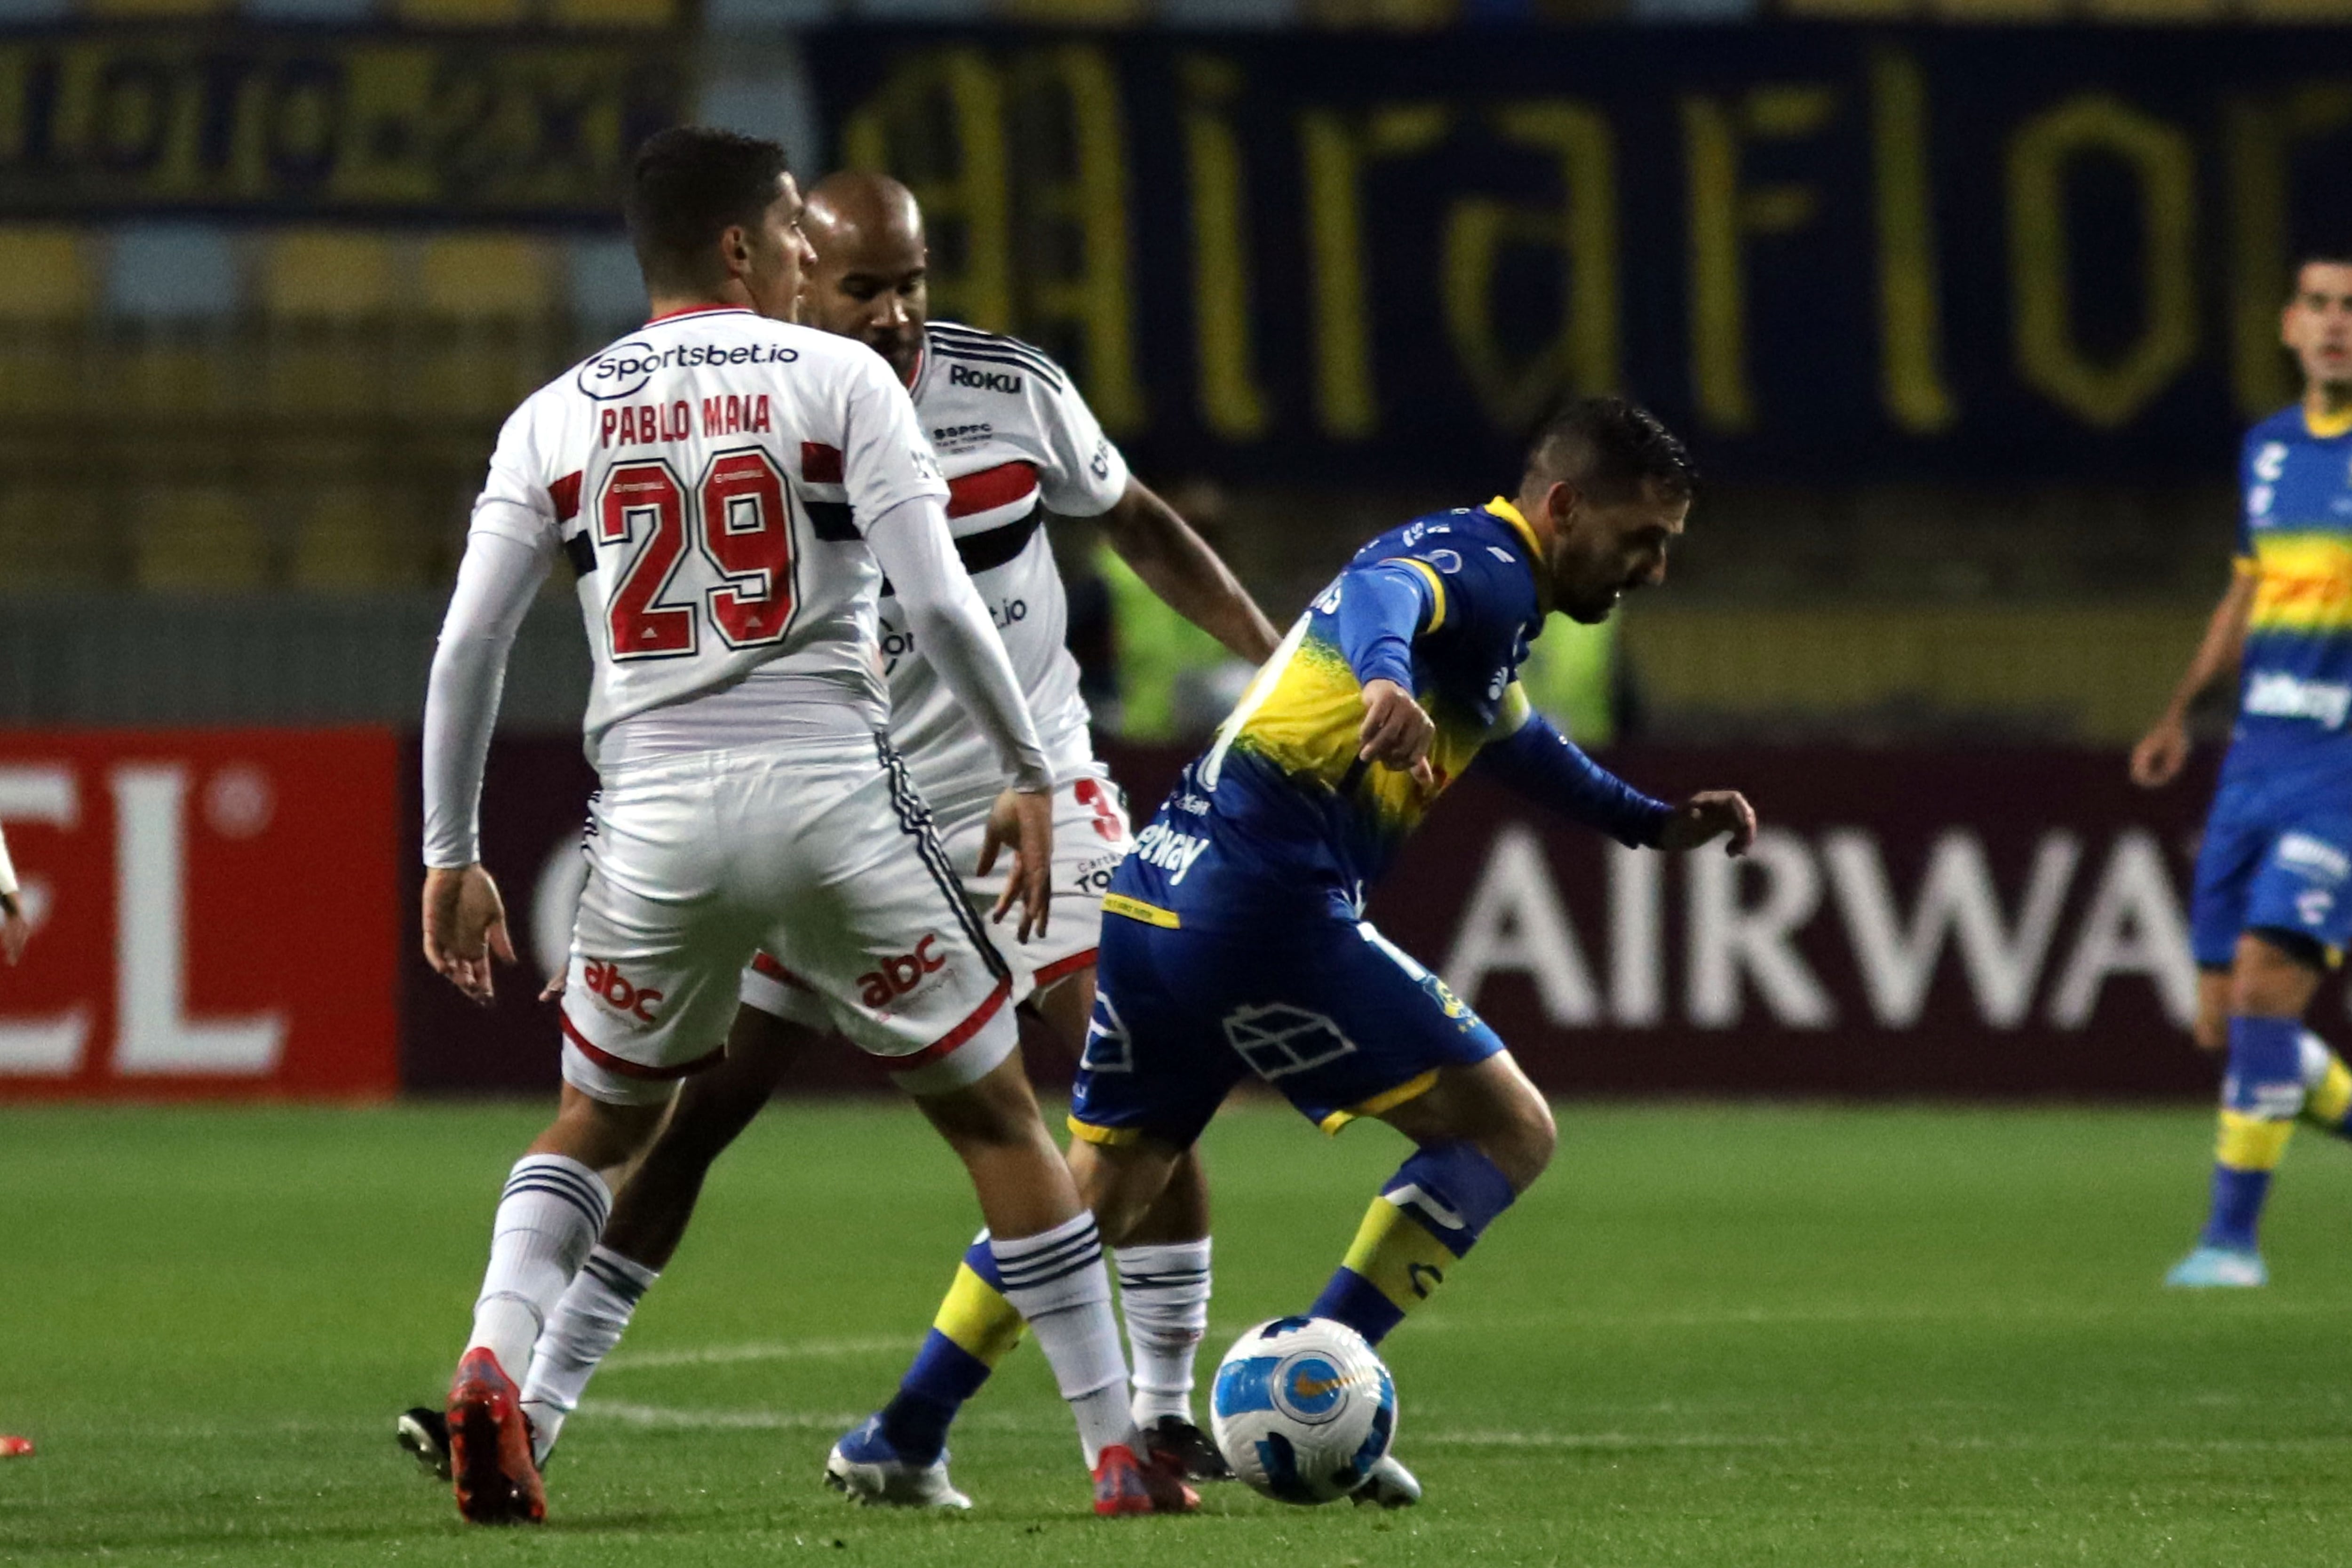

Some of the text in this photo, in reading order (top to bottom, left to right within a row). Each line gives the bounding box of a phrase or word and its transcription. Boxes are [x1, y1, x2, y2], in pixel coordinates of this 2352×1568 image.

[601, 394, 771, 449] PABLO MAIA
[595, 445, 801, 661] 29
[1074, 778, 1121, 842] 3
[1129, 819, 1210, 886] etway
[1443, 826, 2202, 1030] AIRWA
[585, 959, 663, 1022] abc
[857, 933, 946, 1008] abc
